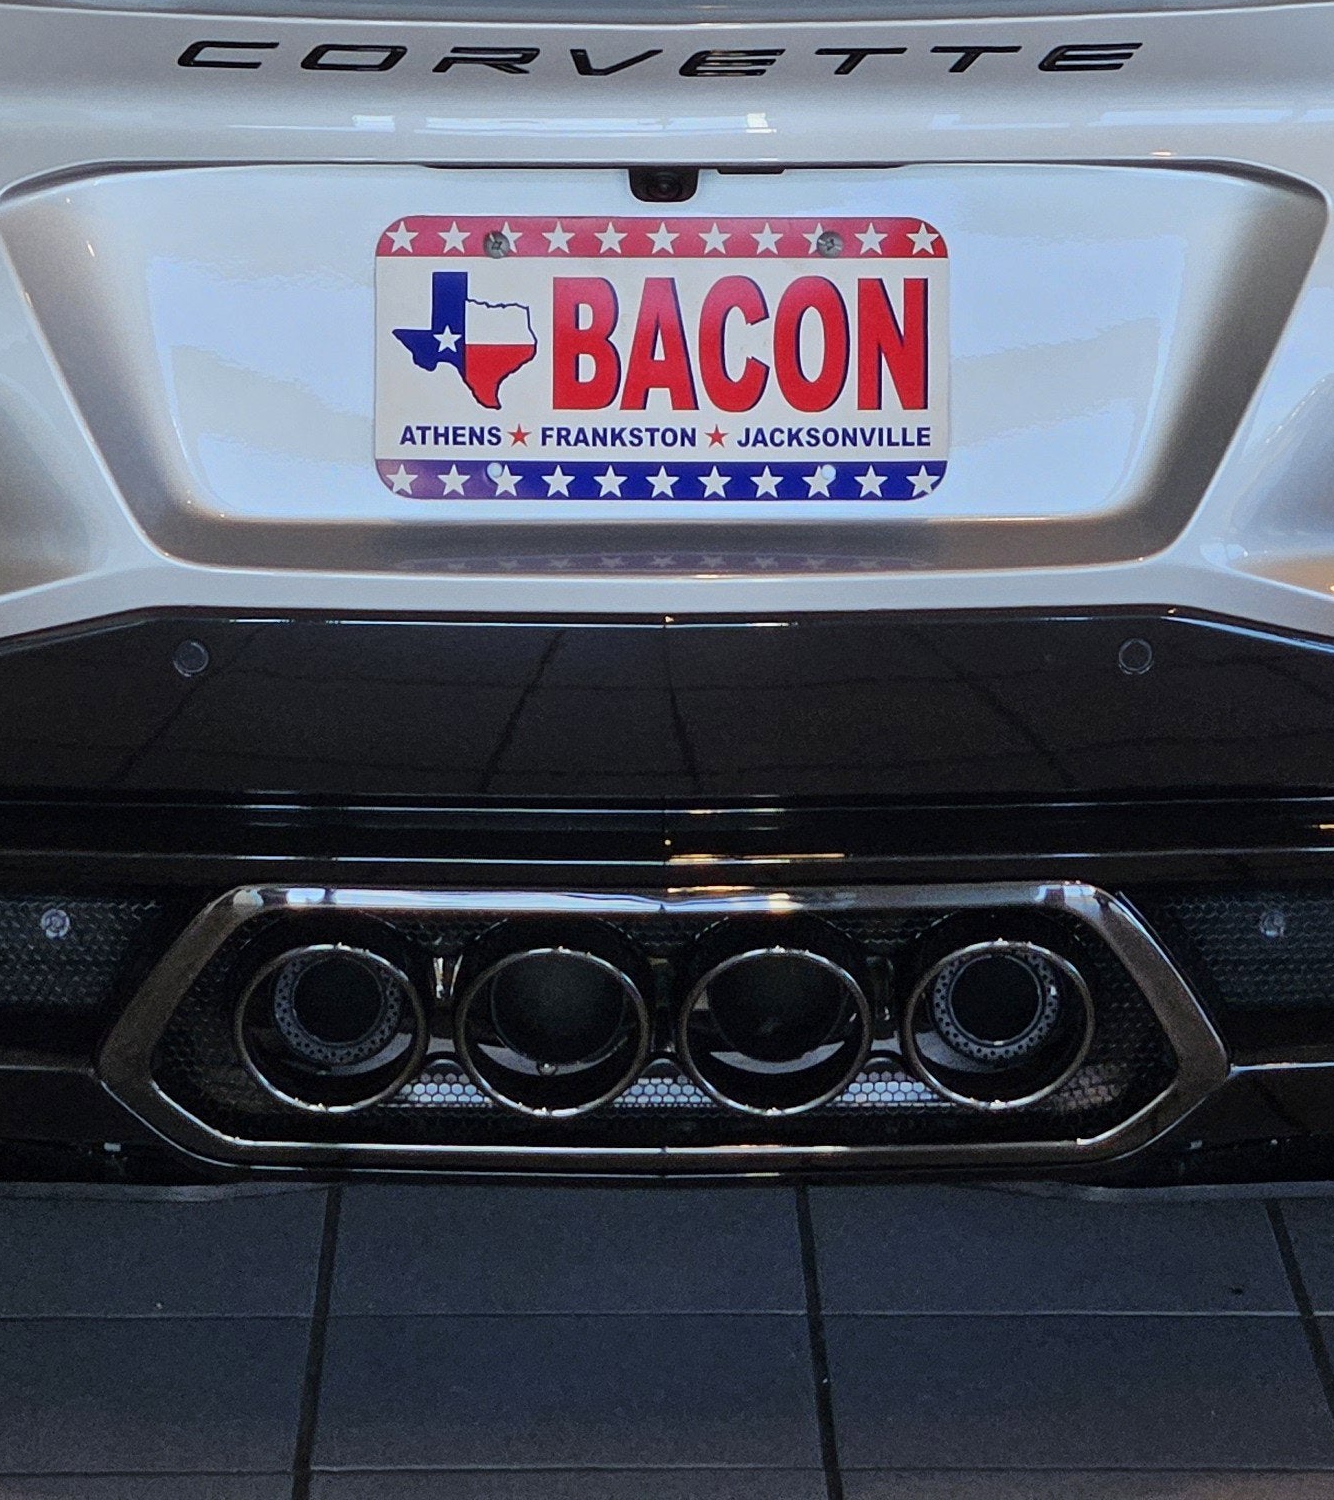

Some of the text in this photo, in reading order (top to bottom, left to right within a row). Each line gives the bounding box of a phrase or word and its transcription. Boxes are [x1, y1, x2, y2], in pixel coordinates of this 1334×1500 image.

[177, 38, 1143, 77] CORVETTE
[552, 275, 928, 413] BACON
[399, 425, 931, 448] ATHENS FRANKSTON JACKSONVILLE
